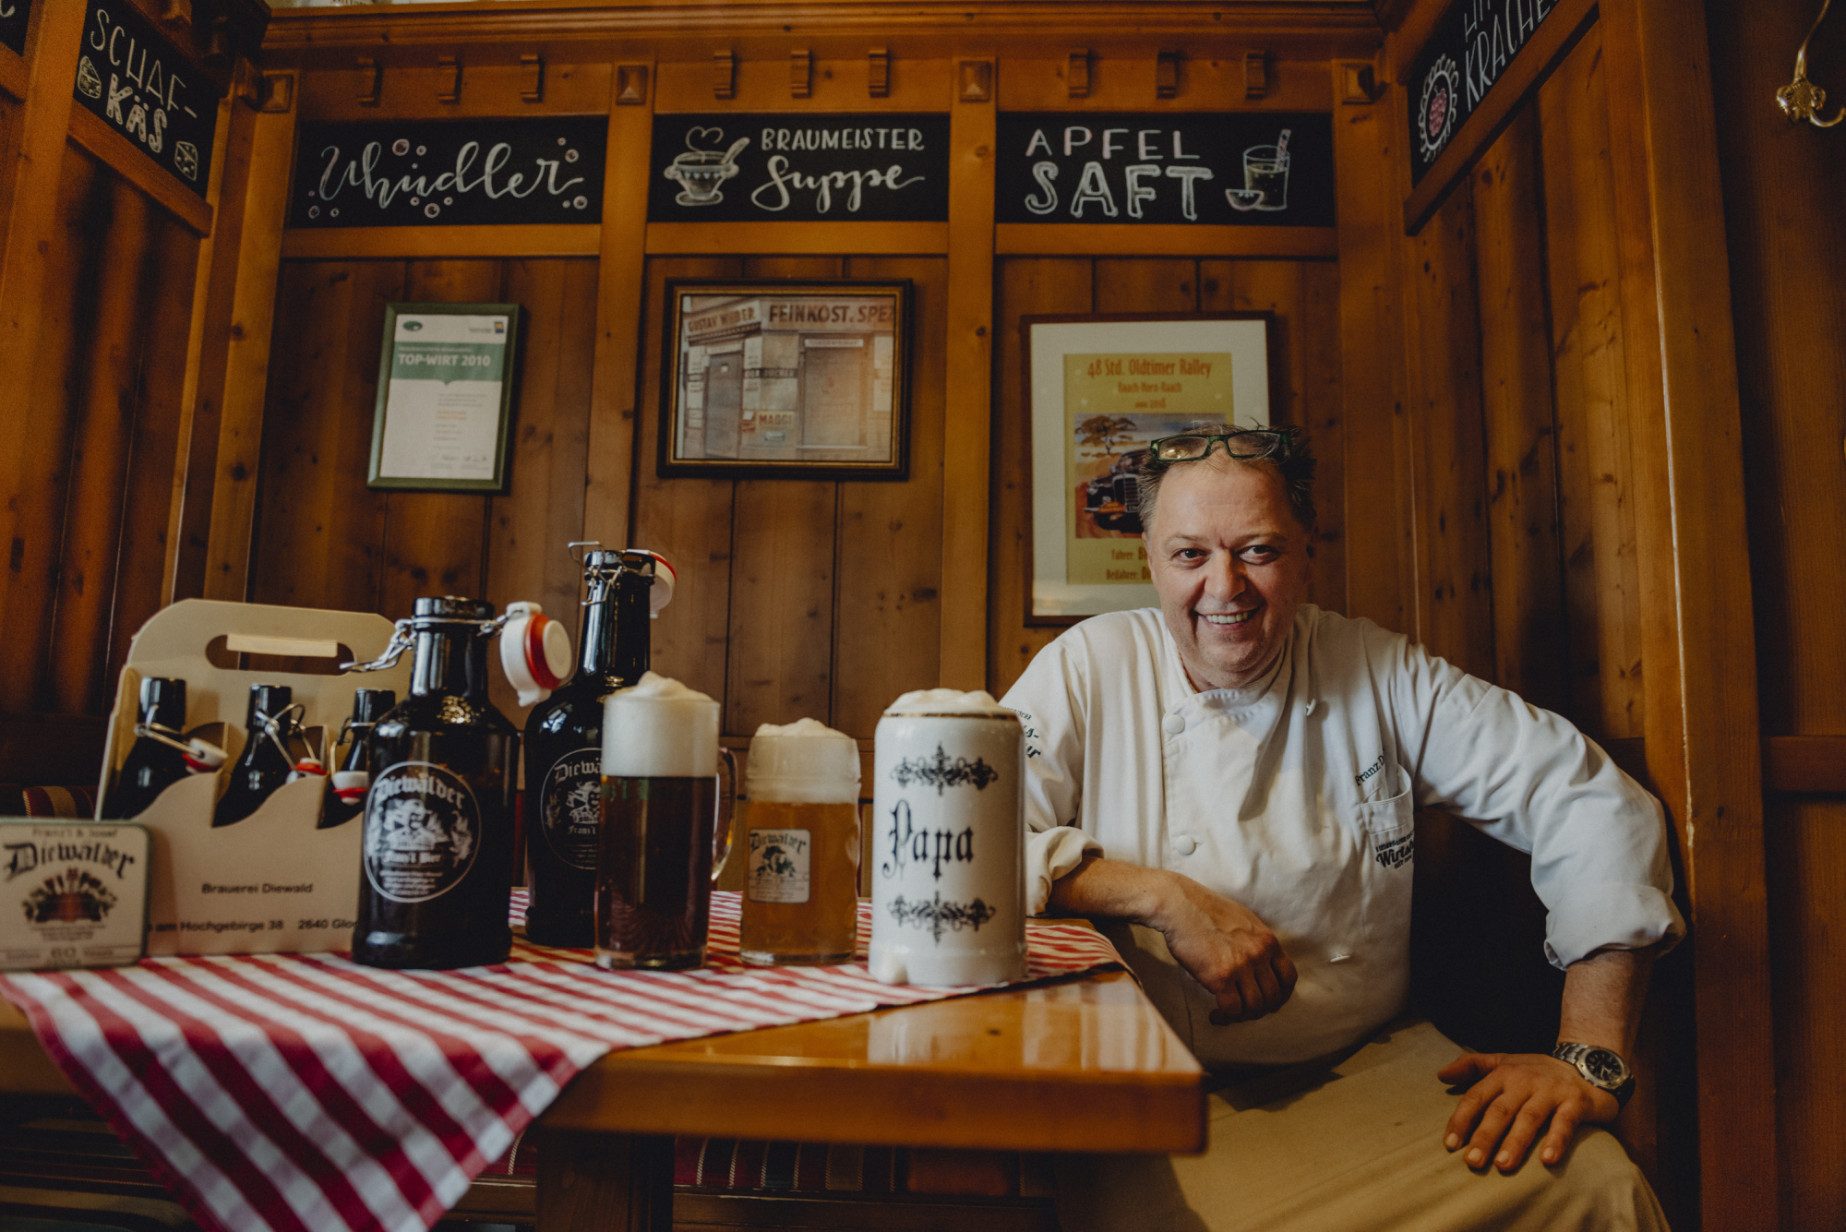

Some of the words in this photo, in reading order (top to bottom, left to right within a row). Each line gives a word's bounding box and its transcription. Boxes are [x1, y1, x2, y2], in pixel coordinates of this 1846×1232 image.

[90, 8, 198, 119] SCHAF-
[106, 72, 169, 154] KÄS
[760, 127, 926, 152] BRAUMEISTER
[1024, 125, 1201, 161] APFEL
[750, 154, 926, 214] Suppe
[1023, 160, 1215, 222] SAFT
[398, 353, 459, 366] TOP-WIRT
[461, 355, 491, 367] 2010
[1128, 358, 1176, 376] Oldtimer
[1355, 763, 1381, 786] Franz
[881, 799, 975, 881] Papa
[202, 883, 259, 894] Brauerei
[261, 882, 314, 894] Diewald
[179, 920, 265, 933] Hochgebirge
[298, 918, 329, 930] 2640
